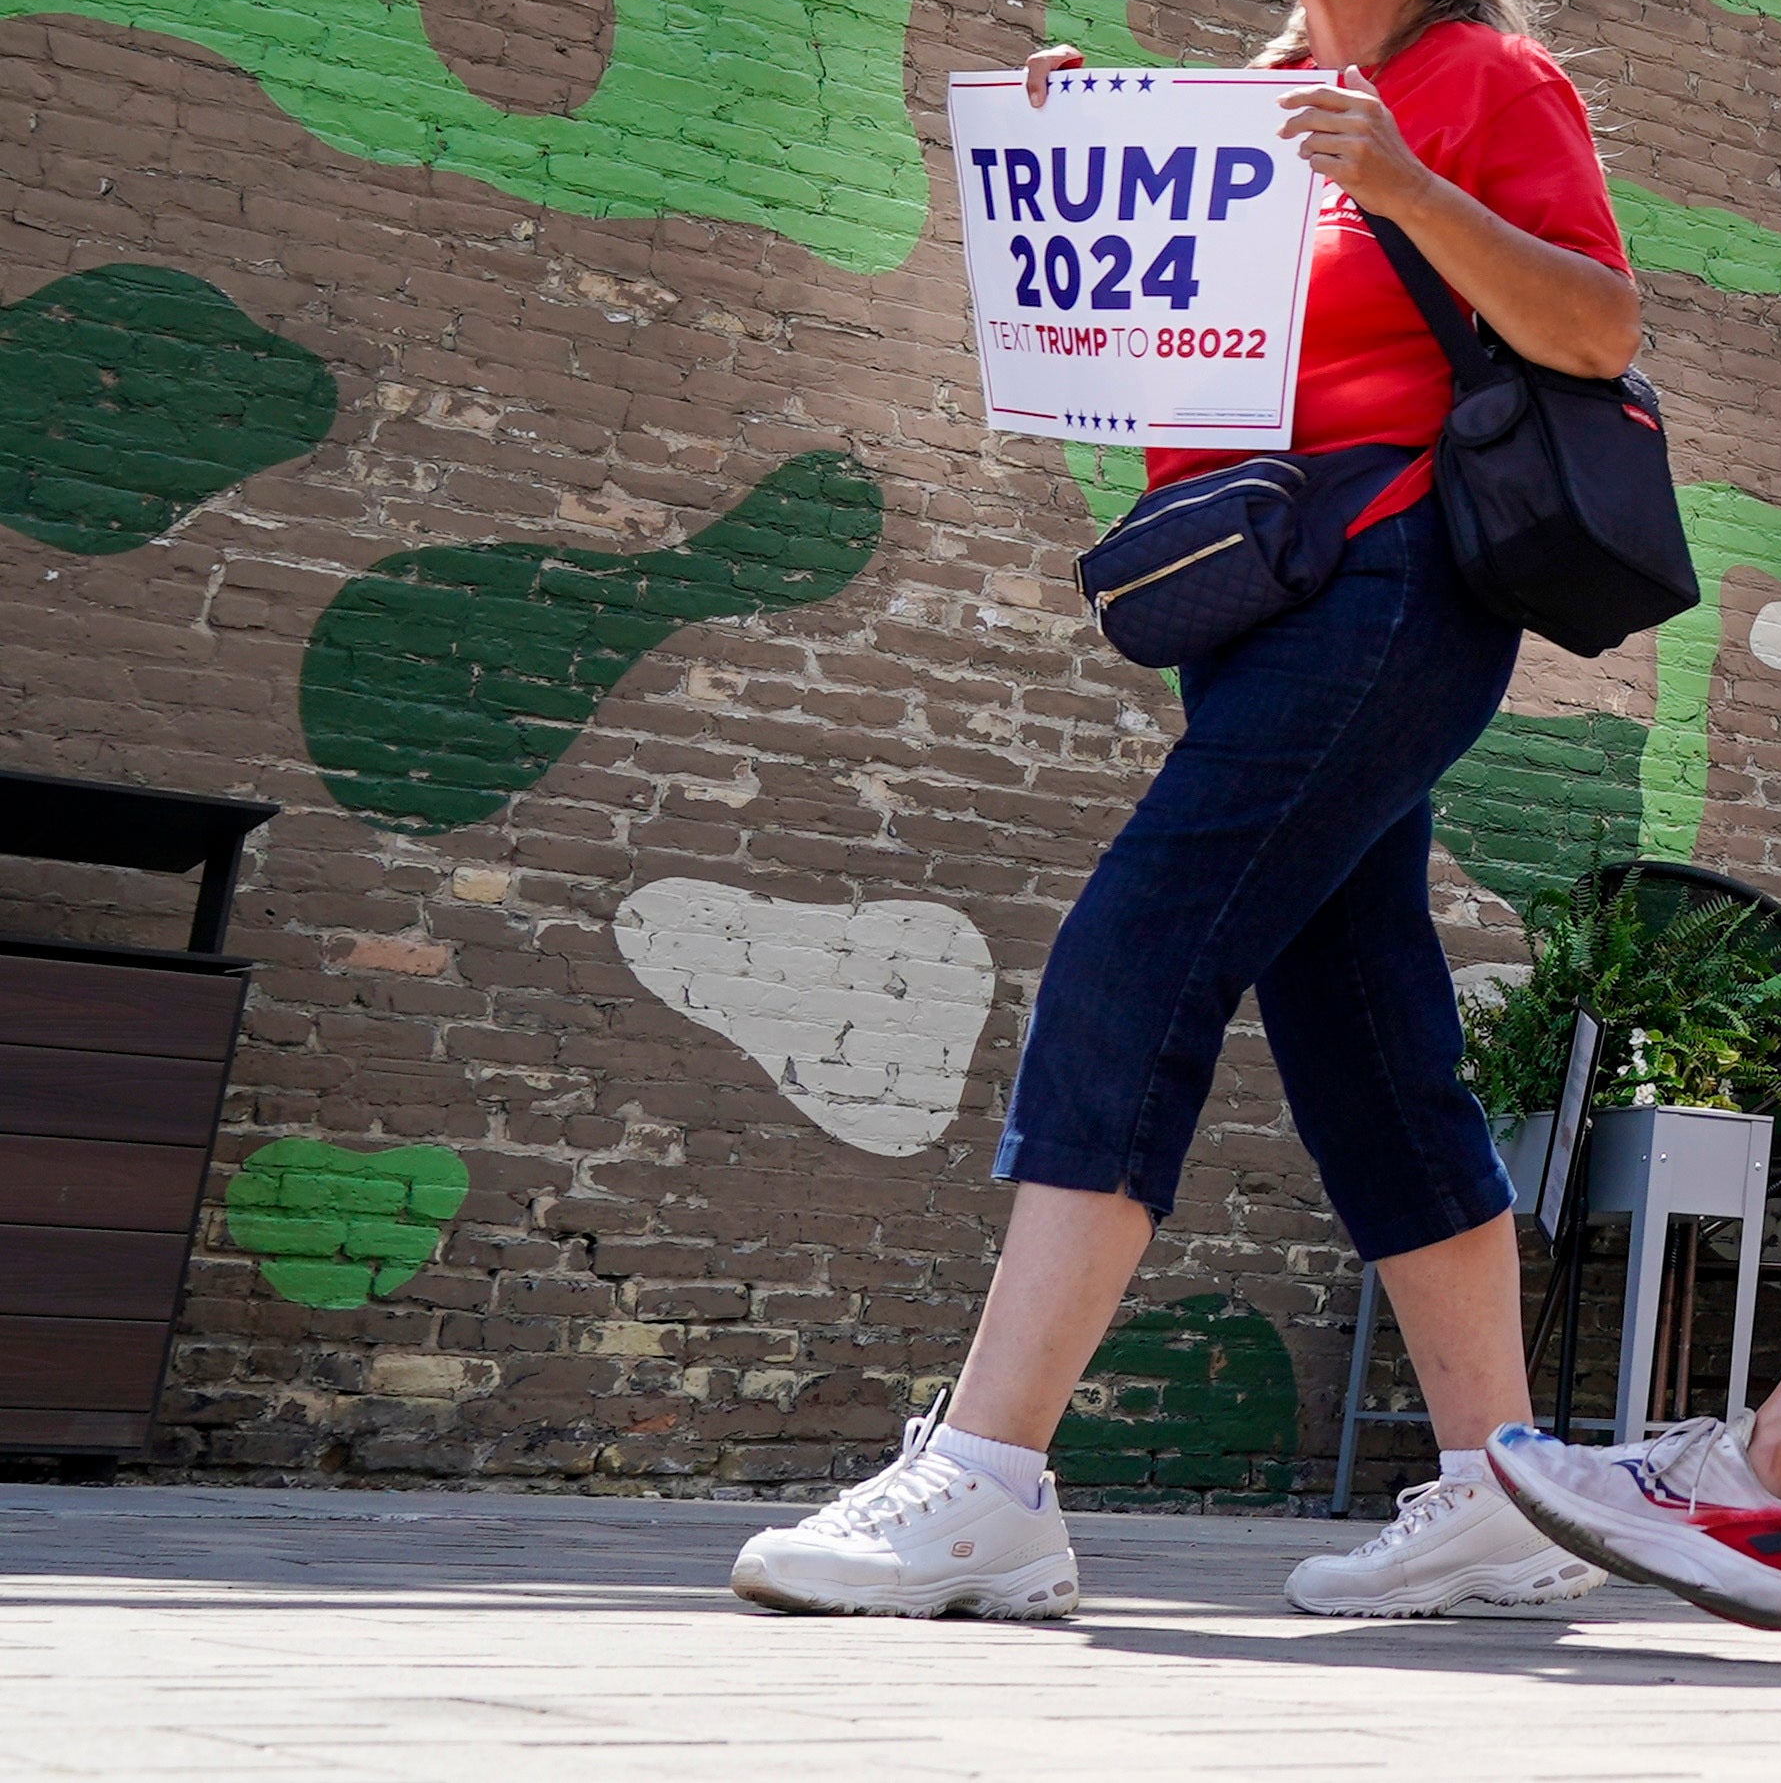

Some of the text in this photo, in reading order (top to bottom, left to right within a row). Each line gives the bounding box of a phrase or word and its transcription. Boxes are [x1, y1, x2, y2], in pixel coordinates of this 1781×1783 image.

[970, 145, 1275, 223] TRUMP
[1009, 234, 1200, 311] 2024
[987, 320, 1268, 360] TEXT TRUMP TO 88022
